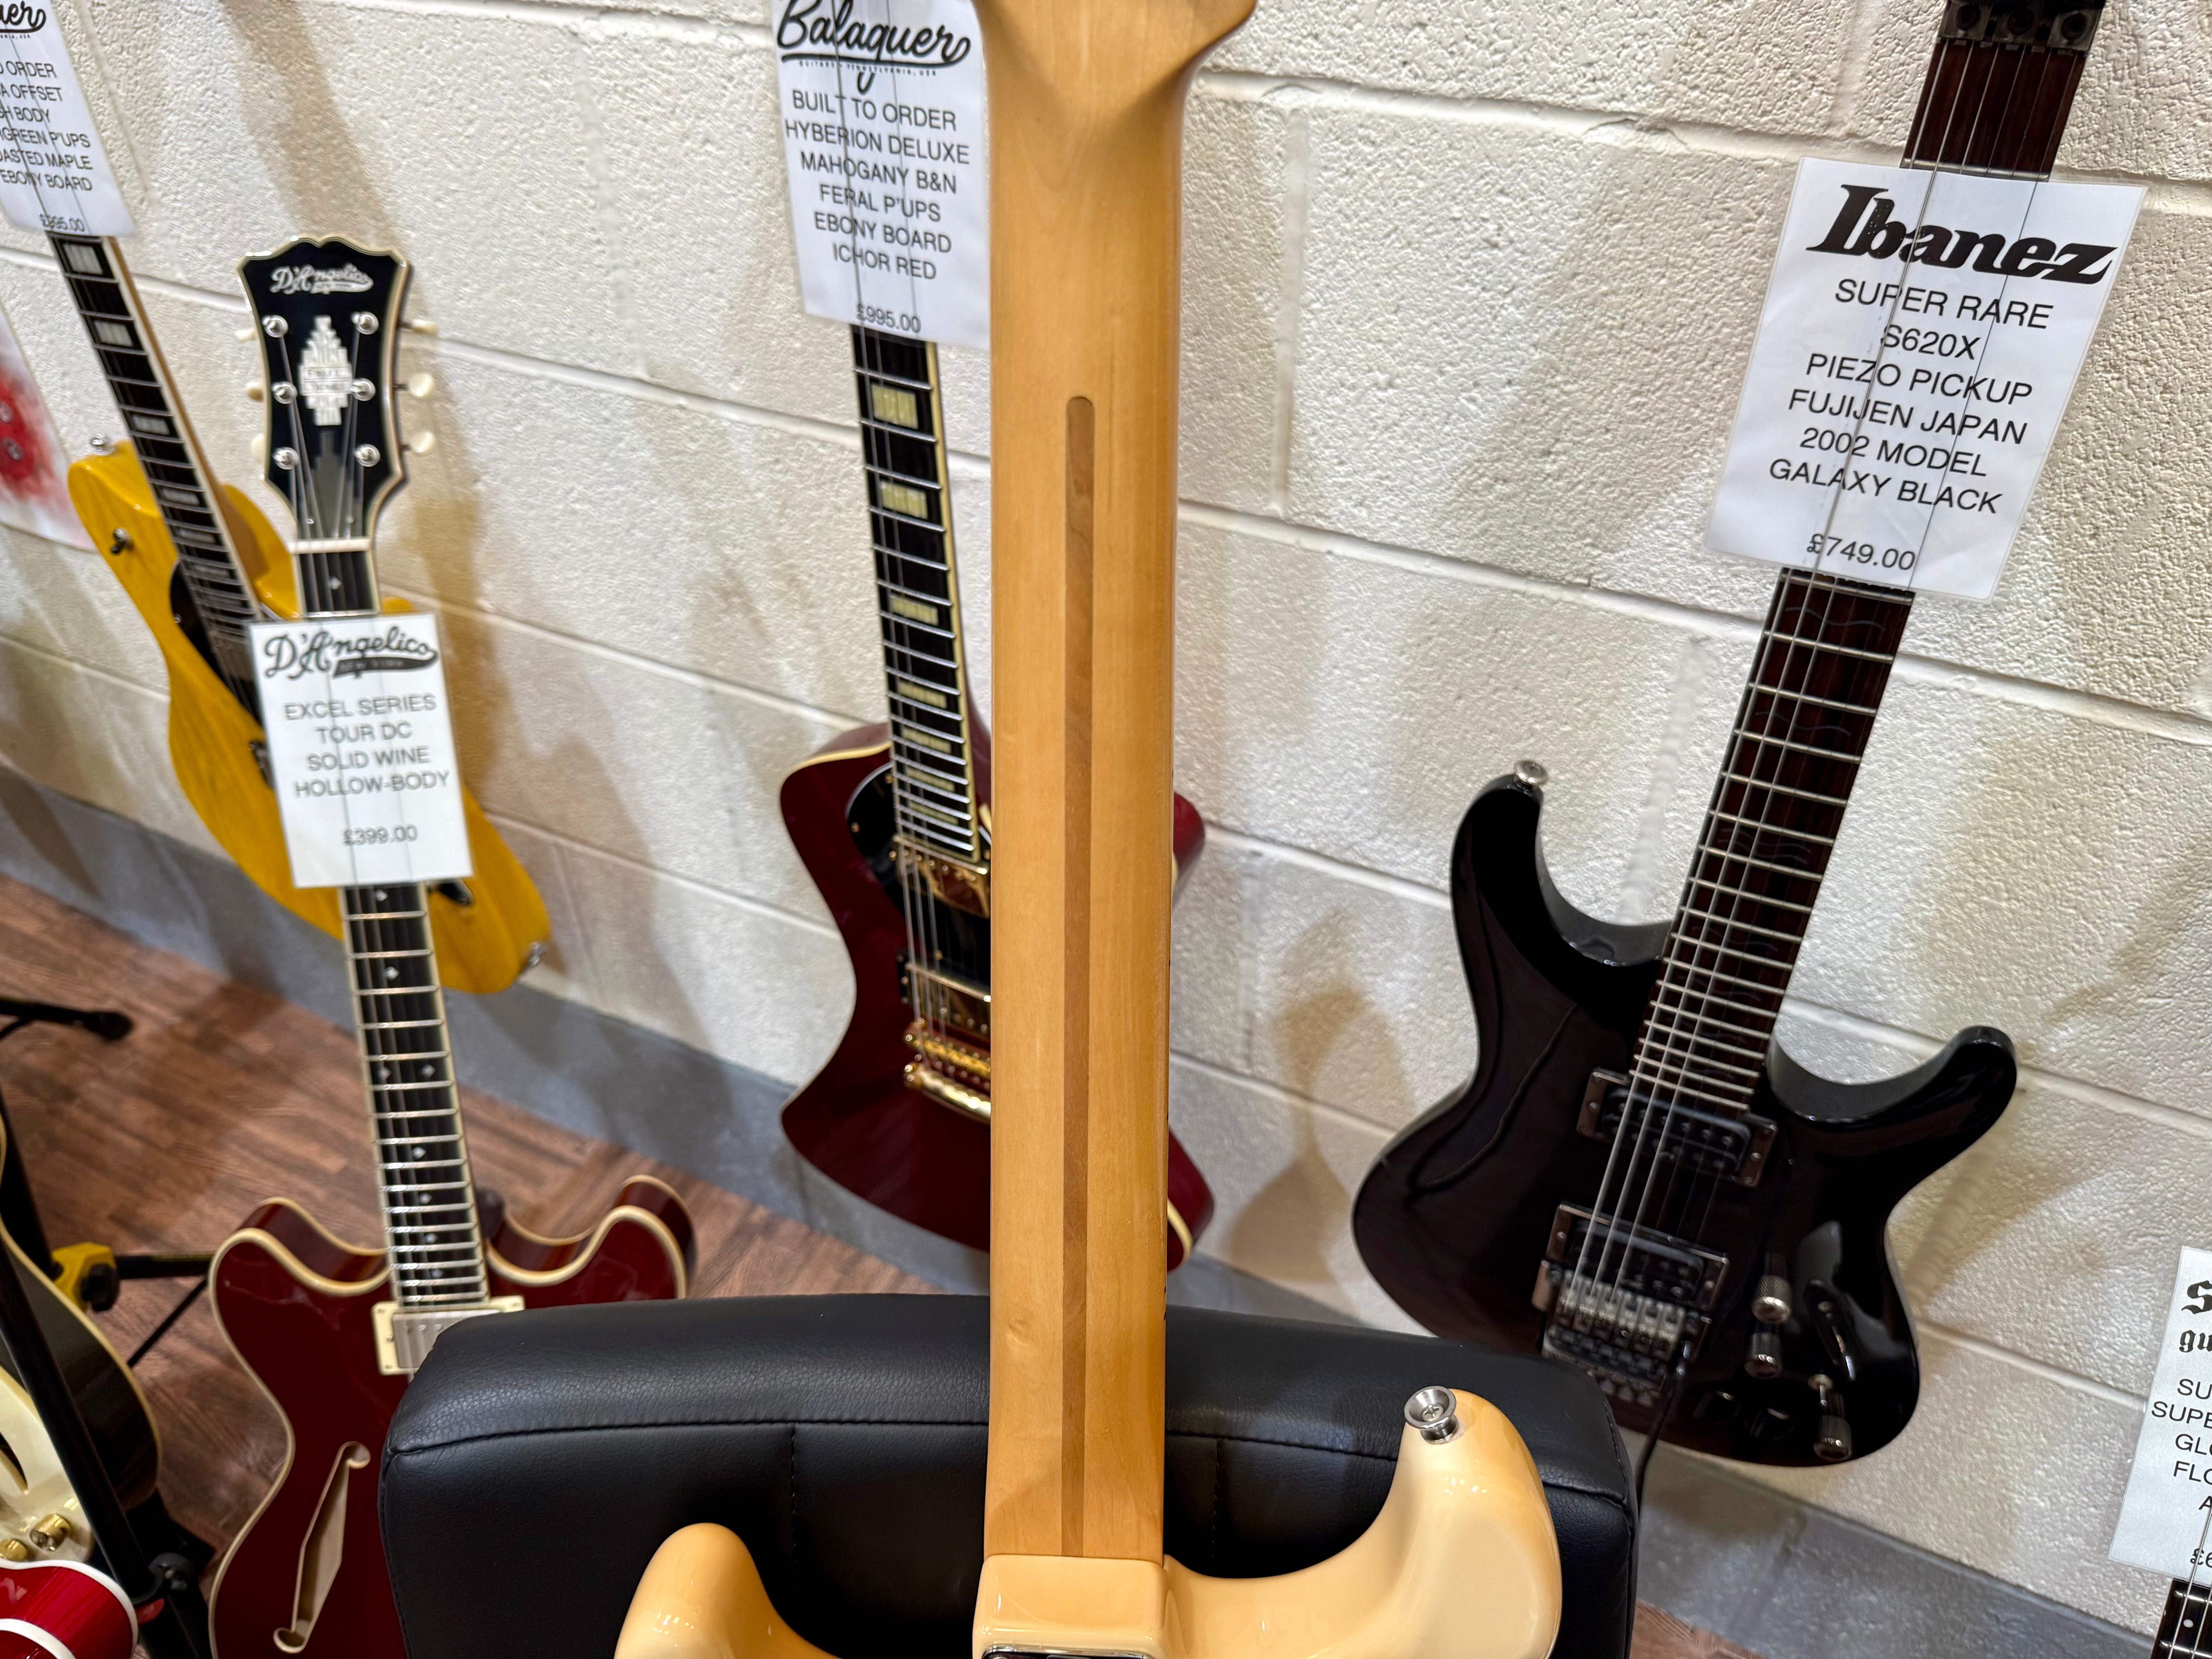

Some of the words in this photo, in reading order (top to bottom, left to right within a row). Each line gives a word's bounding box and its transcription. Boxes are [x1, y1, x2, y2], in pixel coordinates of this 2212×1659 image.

[777, 0, 971, 94] Balaguer
[6, 61, 57, 78] ORDER
[10, 84, 62, 101] OFFSET
[793, 90, 845, 115] BUILT
[851, 98, 876, 120] TO
[883, 103, 956, 131] ORDER
[13, 106, 50, 123] BODY
[49, 132, 90, 148] P'UPS
[785, 119, 882, 152] HYBERION
[888, 135, 970, 164] DELUXE
[45, 153, 93, 170] MAPLE
[801, 151, 908, 186] MAHOGANY
[917, 170, 957, 194] B&N
[45, 174, 93, 191] BOARD
[820, 184, 878, 212] FERAL
[884, 196, 941, 222] P'UPS
[814, 211, 876, 239] EBONY
[883, 225, 951, 252] BOARD
[1805, 184, 2119, 284] Ibanez
[833, 243, 890, 272] ICHOR
[896, 256, 936, 280] RED
[856, 303, 921, 333] £995.00
[1835, 279, 1948, 316] SUPER
[1956, 295, 2054, 329] RARE
[1880, 325, 1980, 360] S620X
[1806, 353, 1901, 386] PIEZO
[1909, 369, 2032, 405] PICKUP
[1788, 389, 1914, 428] FUJIJEN
[1920, 411, 2027, 445] JAPAN
[1800, 428, 1869, 457] 2002
[1877, 440, 1987, 477] MODEL
[1769, 459, 1891, 496] GALAXY
[1897, 481, 2003, 514] BLACK
[1807, 534, 1915, 571] £749.00
[264, 626, 438, 680] D'Angelico
[284, 699, 354, 721] EXCEL
[358, 693, 437, 715] SERIES
[315, 724, 375, 744] TOUR
[380, 720, 412, 740] DC
[307, 750, 369, 771] SOLID
[374, 745, 430, 766] WINE
[295, 769, 450, 798] HOLLOW-BODY
[343, 824, 418, 846] £399.00
[2175, 1434, 2212, 1455] GL
